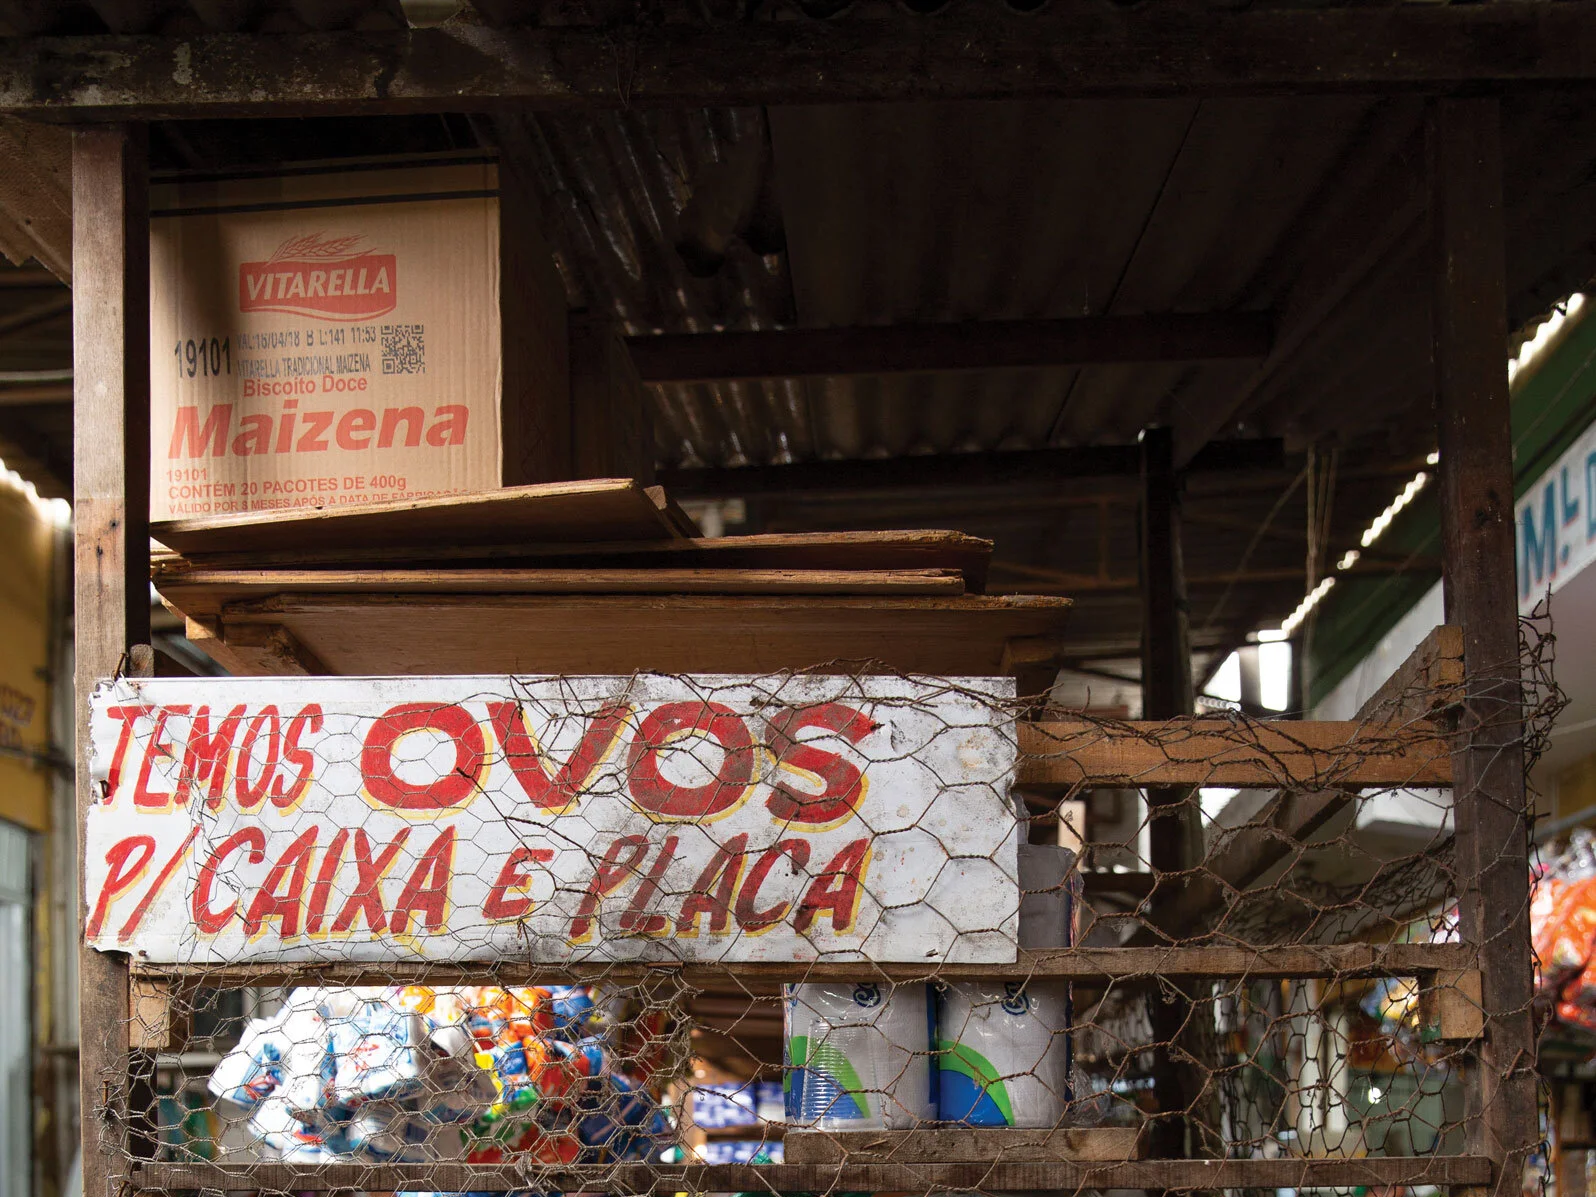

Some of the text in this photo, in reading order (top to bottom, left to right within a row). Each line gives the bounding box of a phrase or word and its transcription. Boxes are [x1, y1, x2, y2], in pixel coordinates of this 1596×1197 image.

[246, 265, 391, 301] VITARELLA
[350, 326, 377, 344] 11:53
[174, 336, 231, 378] 19101
[237, 353, 371, 379] VITARELLA TRADICIONAL MAIZENA
[243, 374, 368, 398] Biscoito Doce
[168, 399, 470, 460] Maizena
[166, 468, 208, 482] 19101
[168, 475, 407, 499] CONTÉM 20 PACOTES DE 400g
[214, 501, 239, 512] POR
[251, 498, 291, 510] MESES
[292, 494, 327, 508] APÓS
[328, 497, 337, 505] A
[339, 493, 369, 504] DATA
[102, 701, 878, 831] TEMOS OVOS
[86, 824, 873, 948] P/ CAIXA E PLACA
